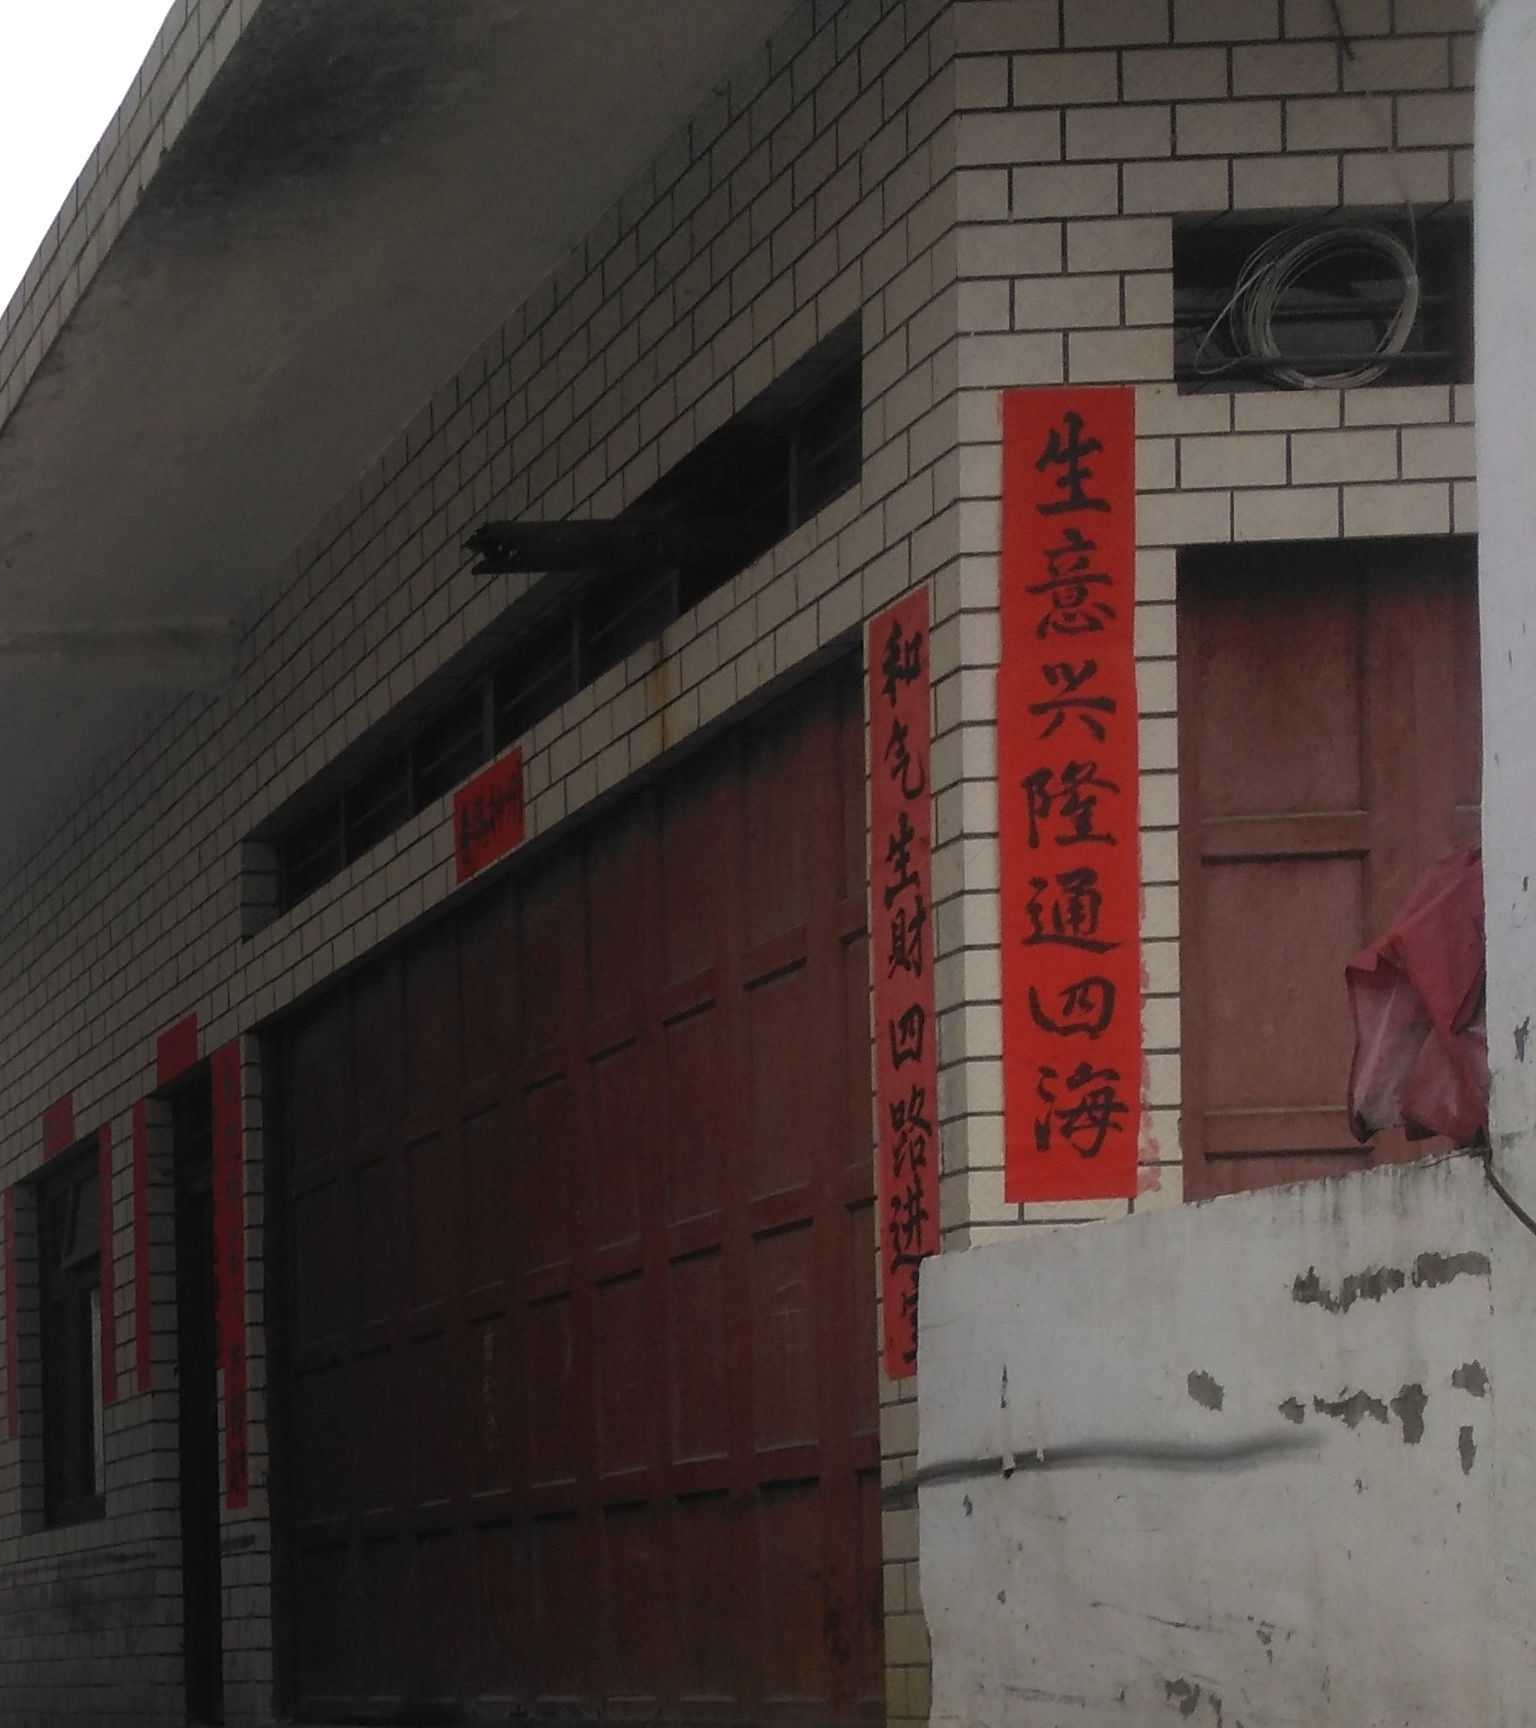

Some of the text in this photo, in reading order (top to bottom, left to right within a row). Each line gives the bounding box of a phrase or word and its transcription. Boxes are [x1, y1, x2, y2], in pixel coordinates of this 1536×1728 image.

[1019, 410, 1130, 1160] 生意兴隆通四海
